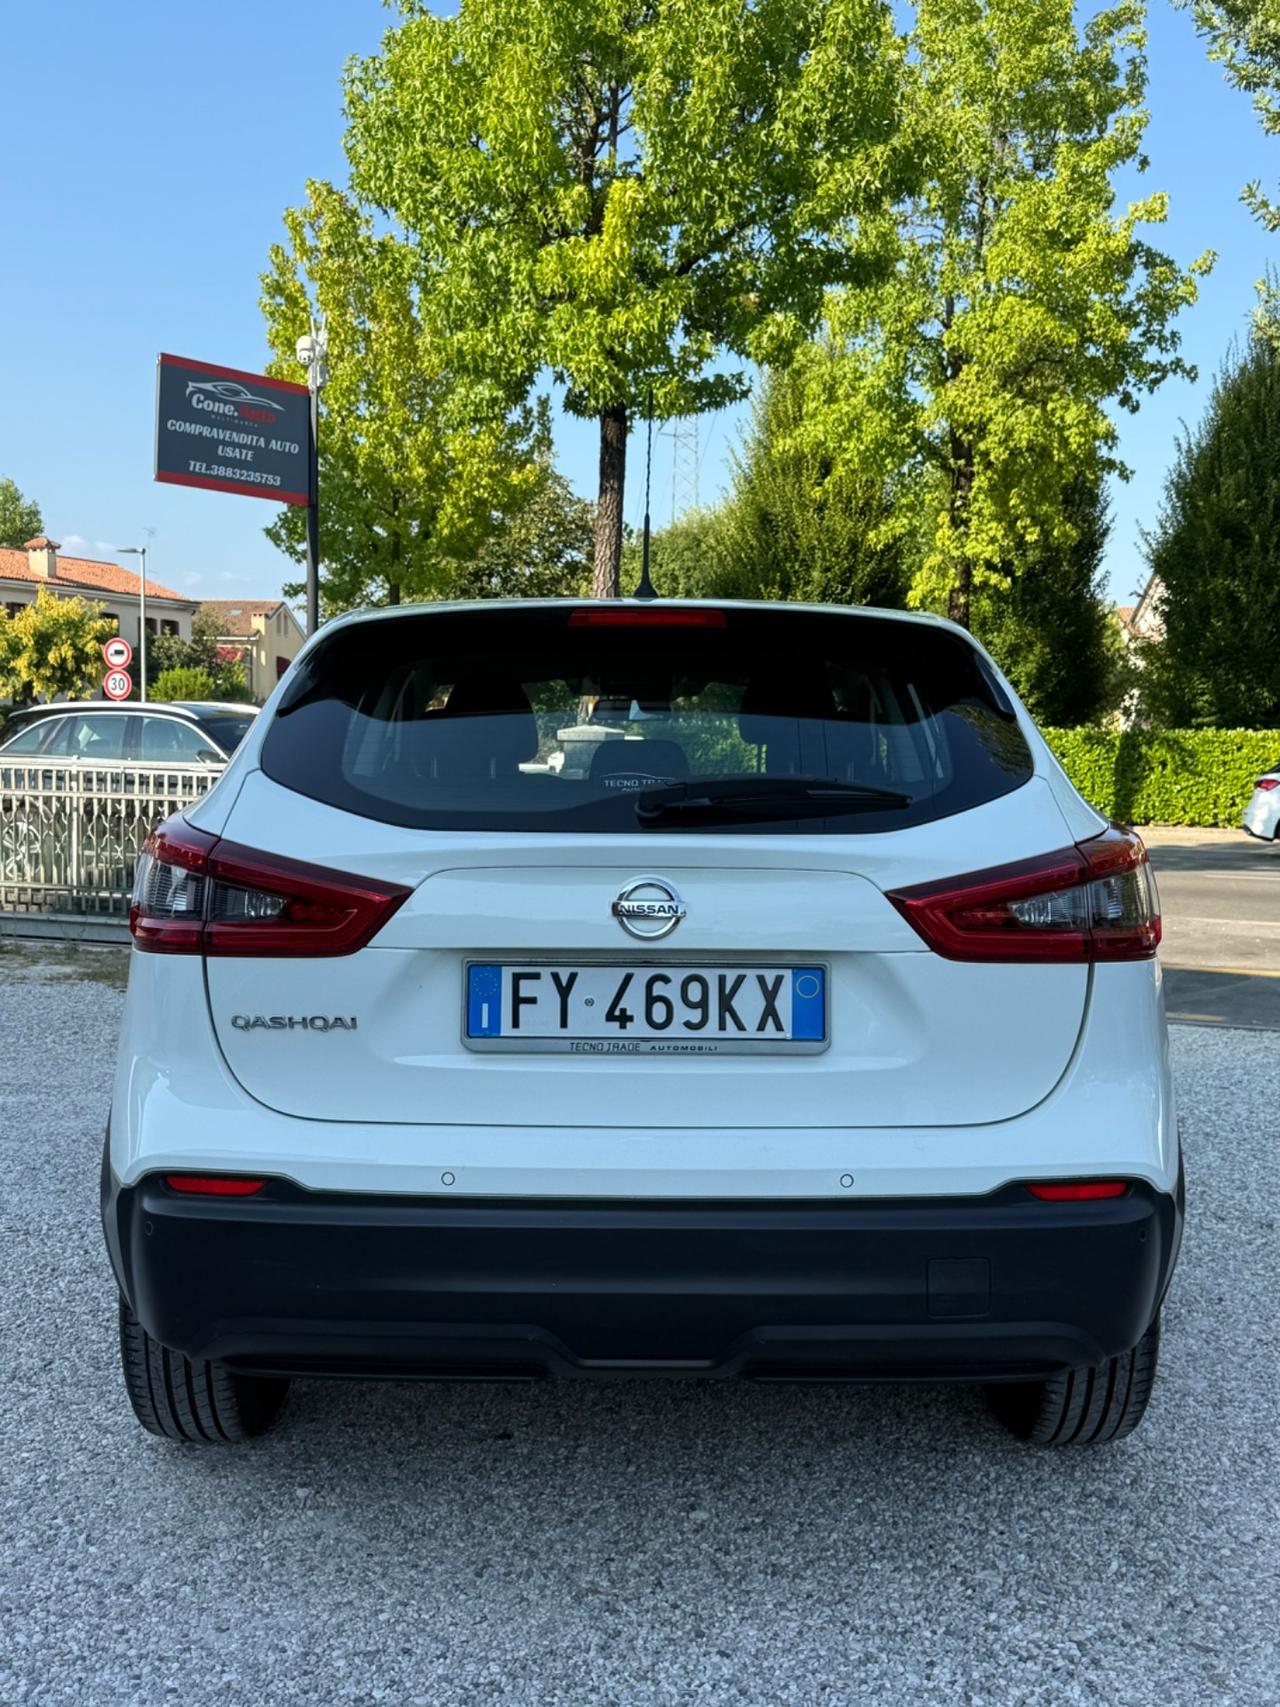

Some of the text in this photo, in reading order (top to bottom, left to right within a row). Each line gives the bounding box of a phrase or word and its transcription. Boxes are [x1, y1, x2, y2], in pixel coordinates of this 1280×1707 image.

[167, 419, 300, 454] COMPRAVENDITA AUTO
[217, 445, 255, 461] USATE
[110, 677, 126, 691] 30
[604, 779, 639, 787] TECNO
[619, 904, 679, 915] NISSAN
[231, 1015, 357, 1032] QASHQAI
[569, 1042, 603, 1052] TECNO
[606, 1042, 641, 1052] TRADE
